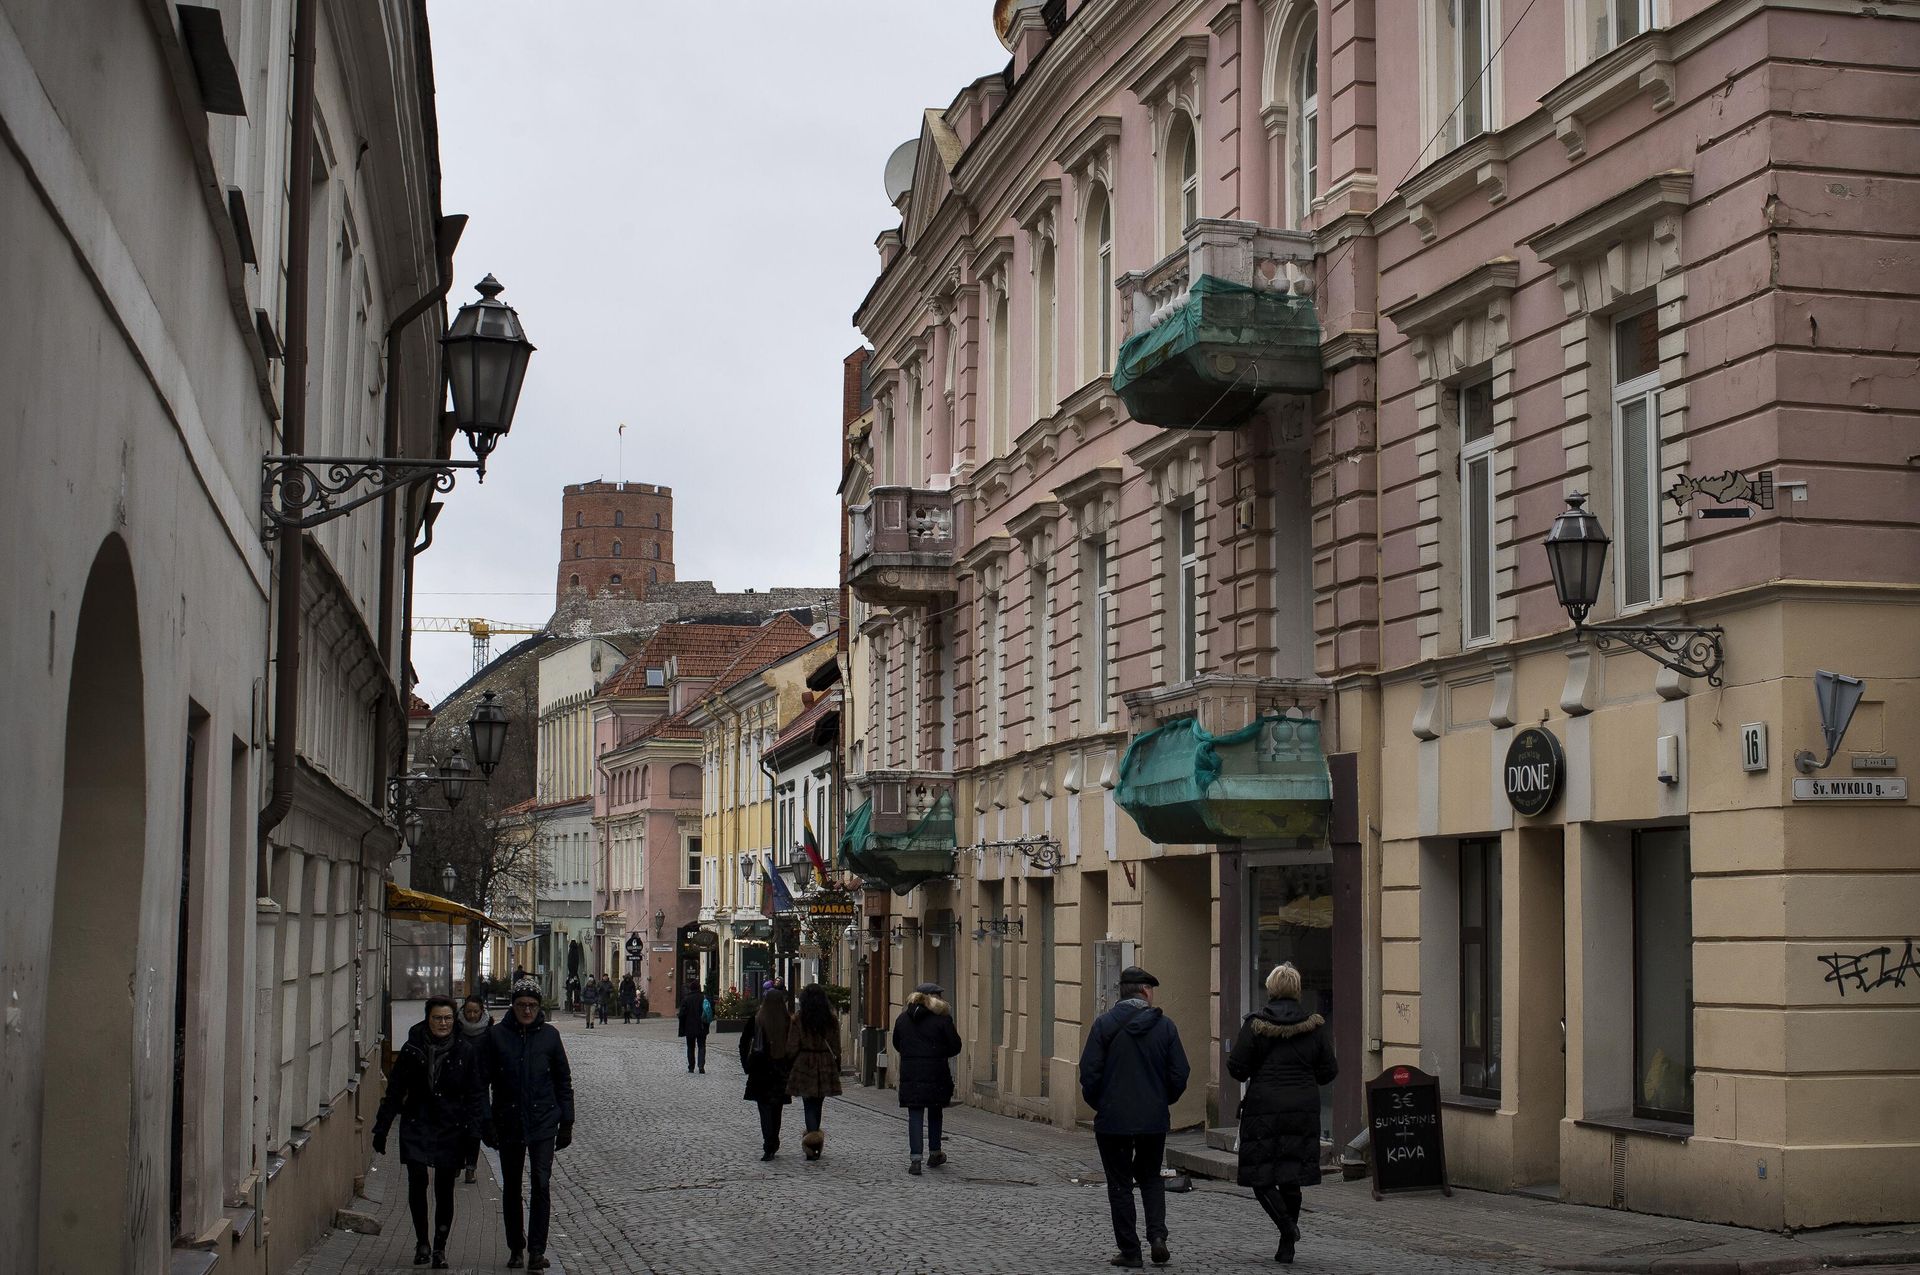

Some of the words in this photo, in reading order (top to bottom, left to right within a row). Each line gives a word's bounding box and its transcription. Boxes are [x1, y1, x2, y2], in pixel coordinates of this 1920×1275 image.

[1745, 729, 1759, 765] 16
[1508, 763, 1550, 793] DIONE
[1812, 780, 1829, 795] Šv.
[1831, 782, 1873, 795] MYKOLO
[1875, 784, 1885, 796] g.
[810, 904, 853, 914] DVARAS
[1391, 1092, 1415, 1109] 3€
[1386, 1144, 1425, 1164] KAVA
